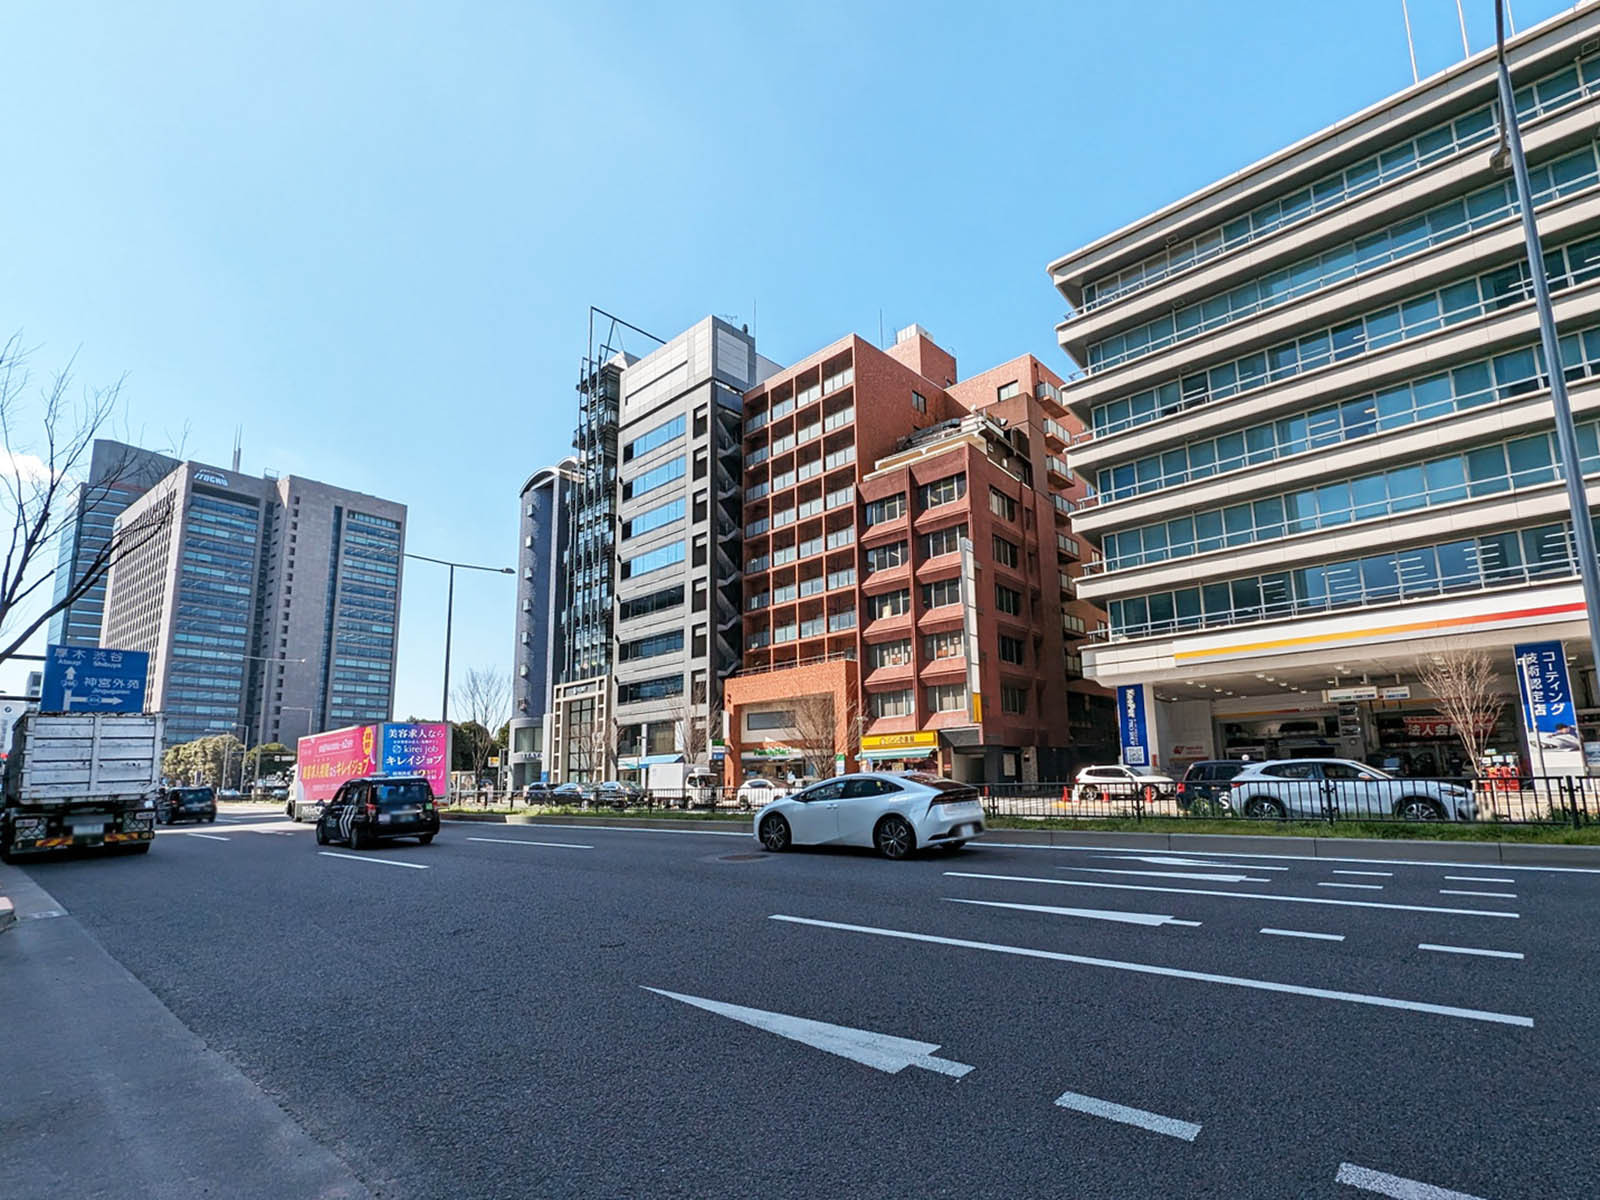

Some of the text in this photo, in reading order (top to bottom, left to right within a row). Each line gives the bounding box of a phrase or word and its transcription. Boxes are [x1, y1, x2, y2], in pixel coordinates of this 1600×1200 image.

[54, 648, 123, 662] 厚木 渋谷
[84, 677, 140, 689] 神宮外苑
[1523, 652, 1547, 717] 技術認定店
[1542, 651, 1565, 716] コーティング
[388, 728, 444, 739] 美容求人なら
[386, 754, 444, 766] キレイジョブ
